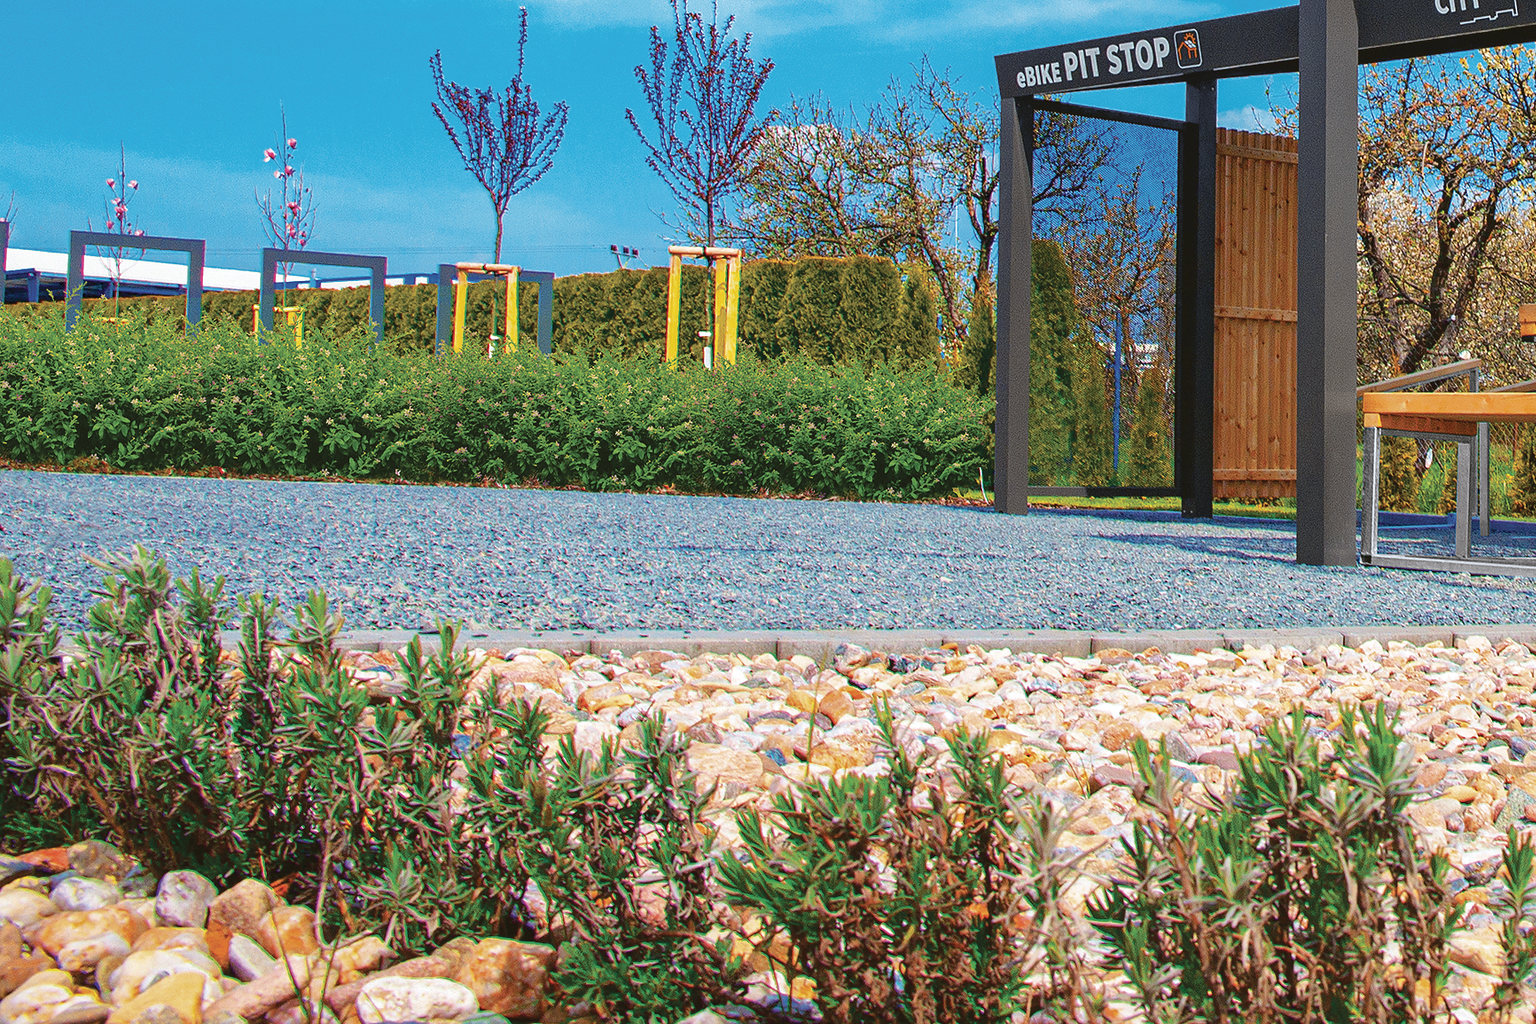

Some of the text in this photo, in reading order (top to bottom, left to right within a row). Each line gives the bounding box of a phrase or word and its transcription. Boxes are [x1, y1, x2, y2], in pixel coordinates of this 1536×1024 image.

[1016, 36, 1170, 89] eBIKE PIT STOP
